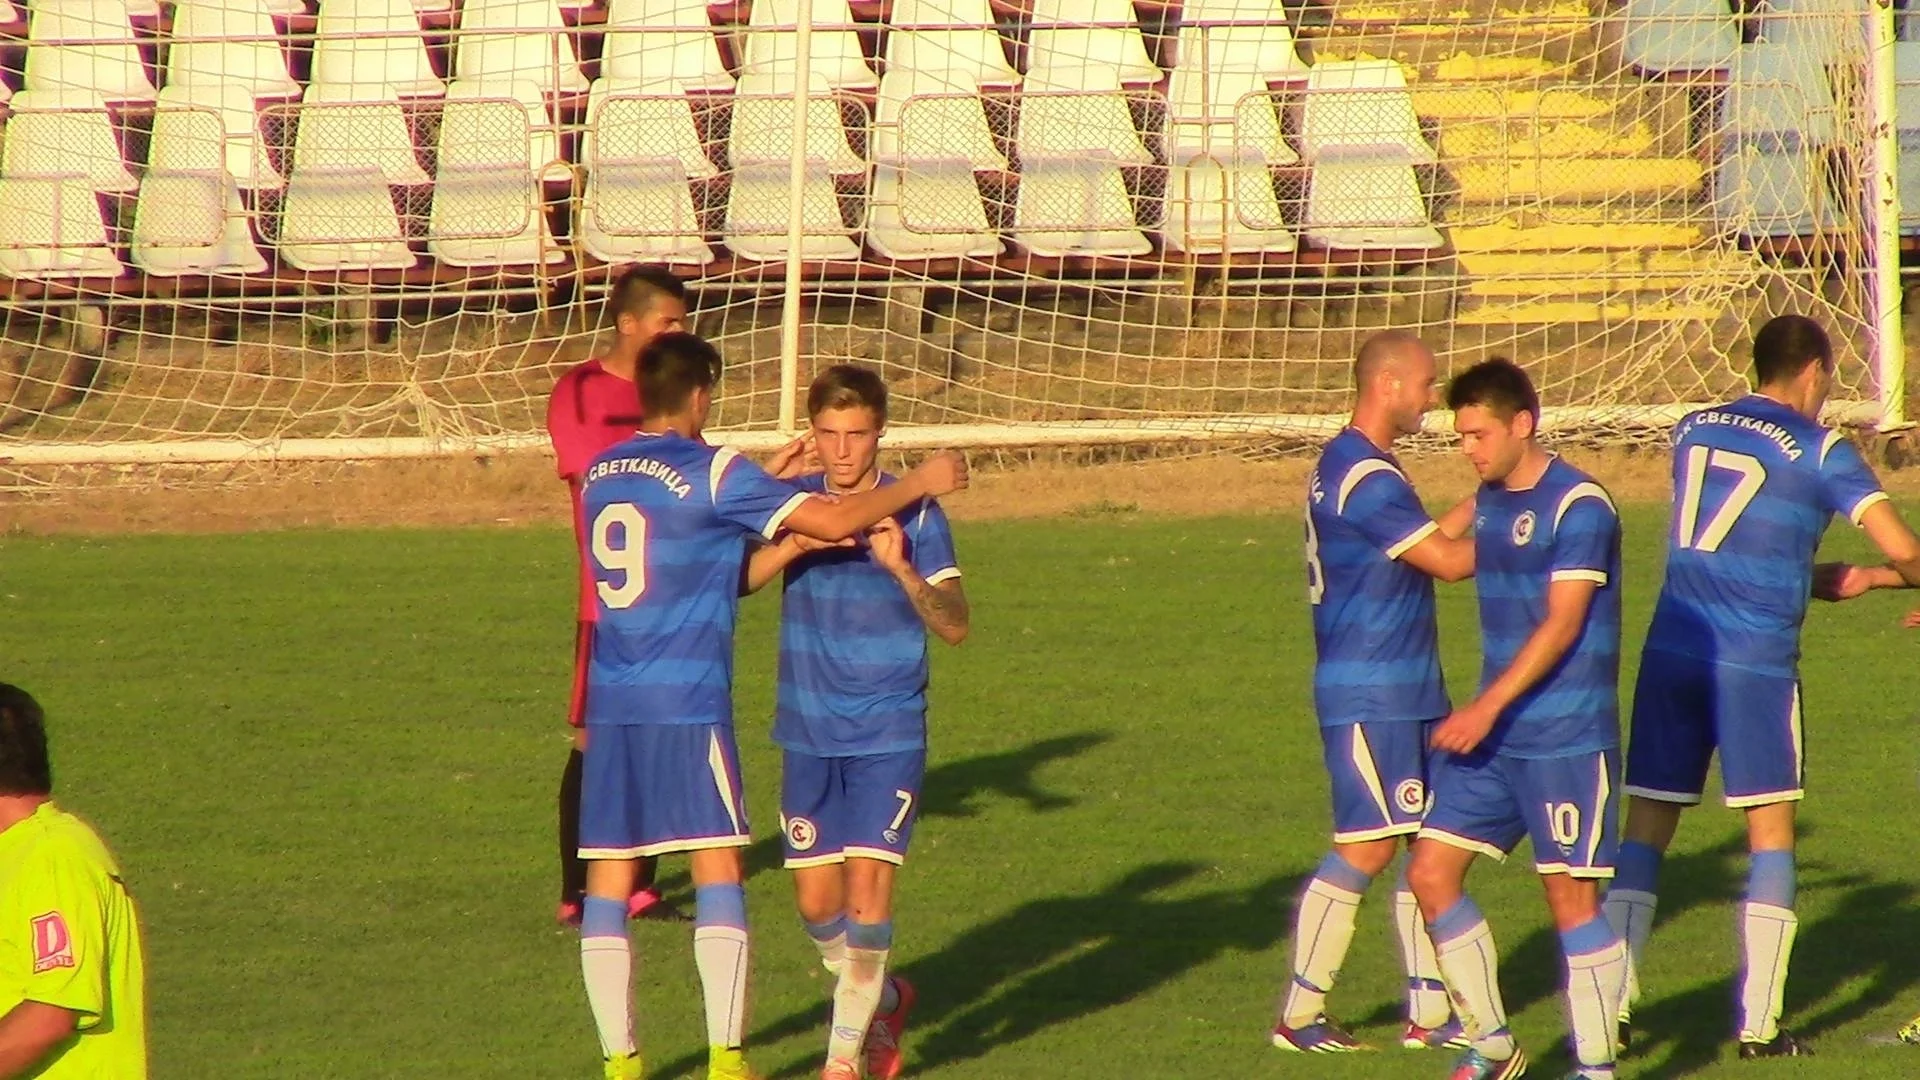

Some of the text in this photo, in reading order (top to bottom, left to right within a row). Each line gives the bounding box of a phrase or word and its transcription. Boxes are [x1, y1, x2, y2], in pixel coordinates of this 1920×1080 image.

[1695, 411, 1804, 462] СВЕТКАВИЦА
[589, 457, 692, 500] СВЕТКАВИЦА
[1679, 445, 1768, 552] 17
[592, 502, 646, 609] 9
[889, 788, 913, 830] 7
[1545, 802, 1580, 845] 10
